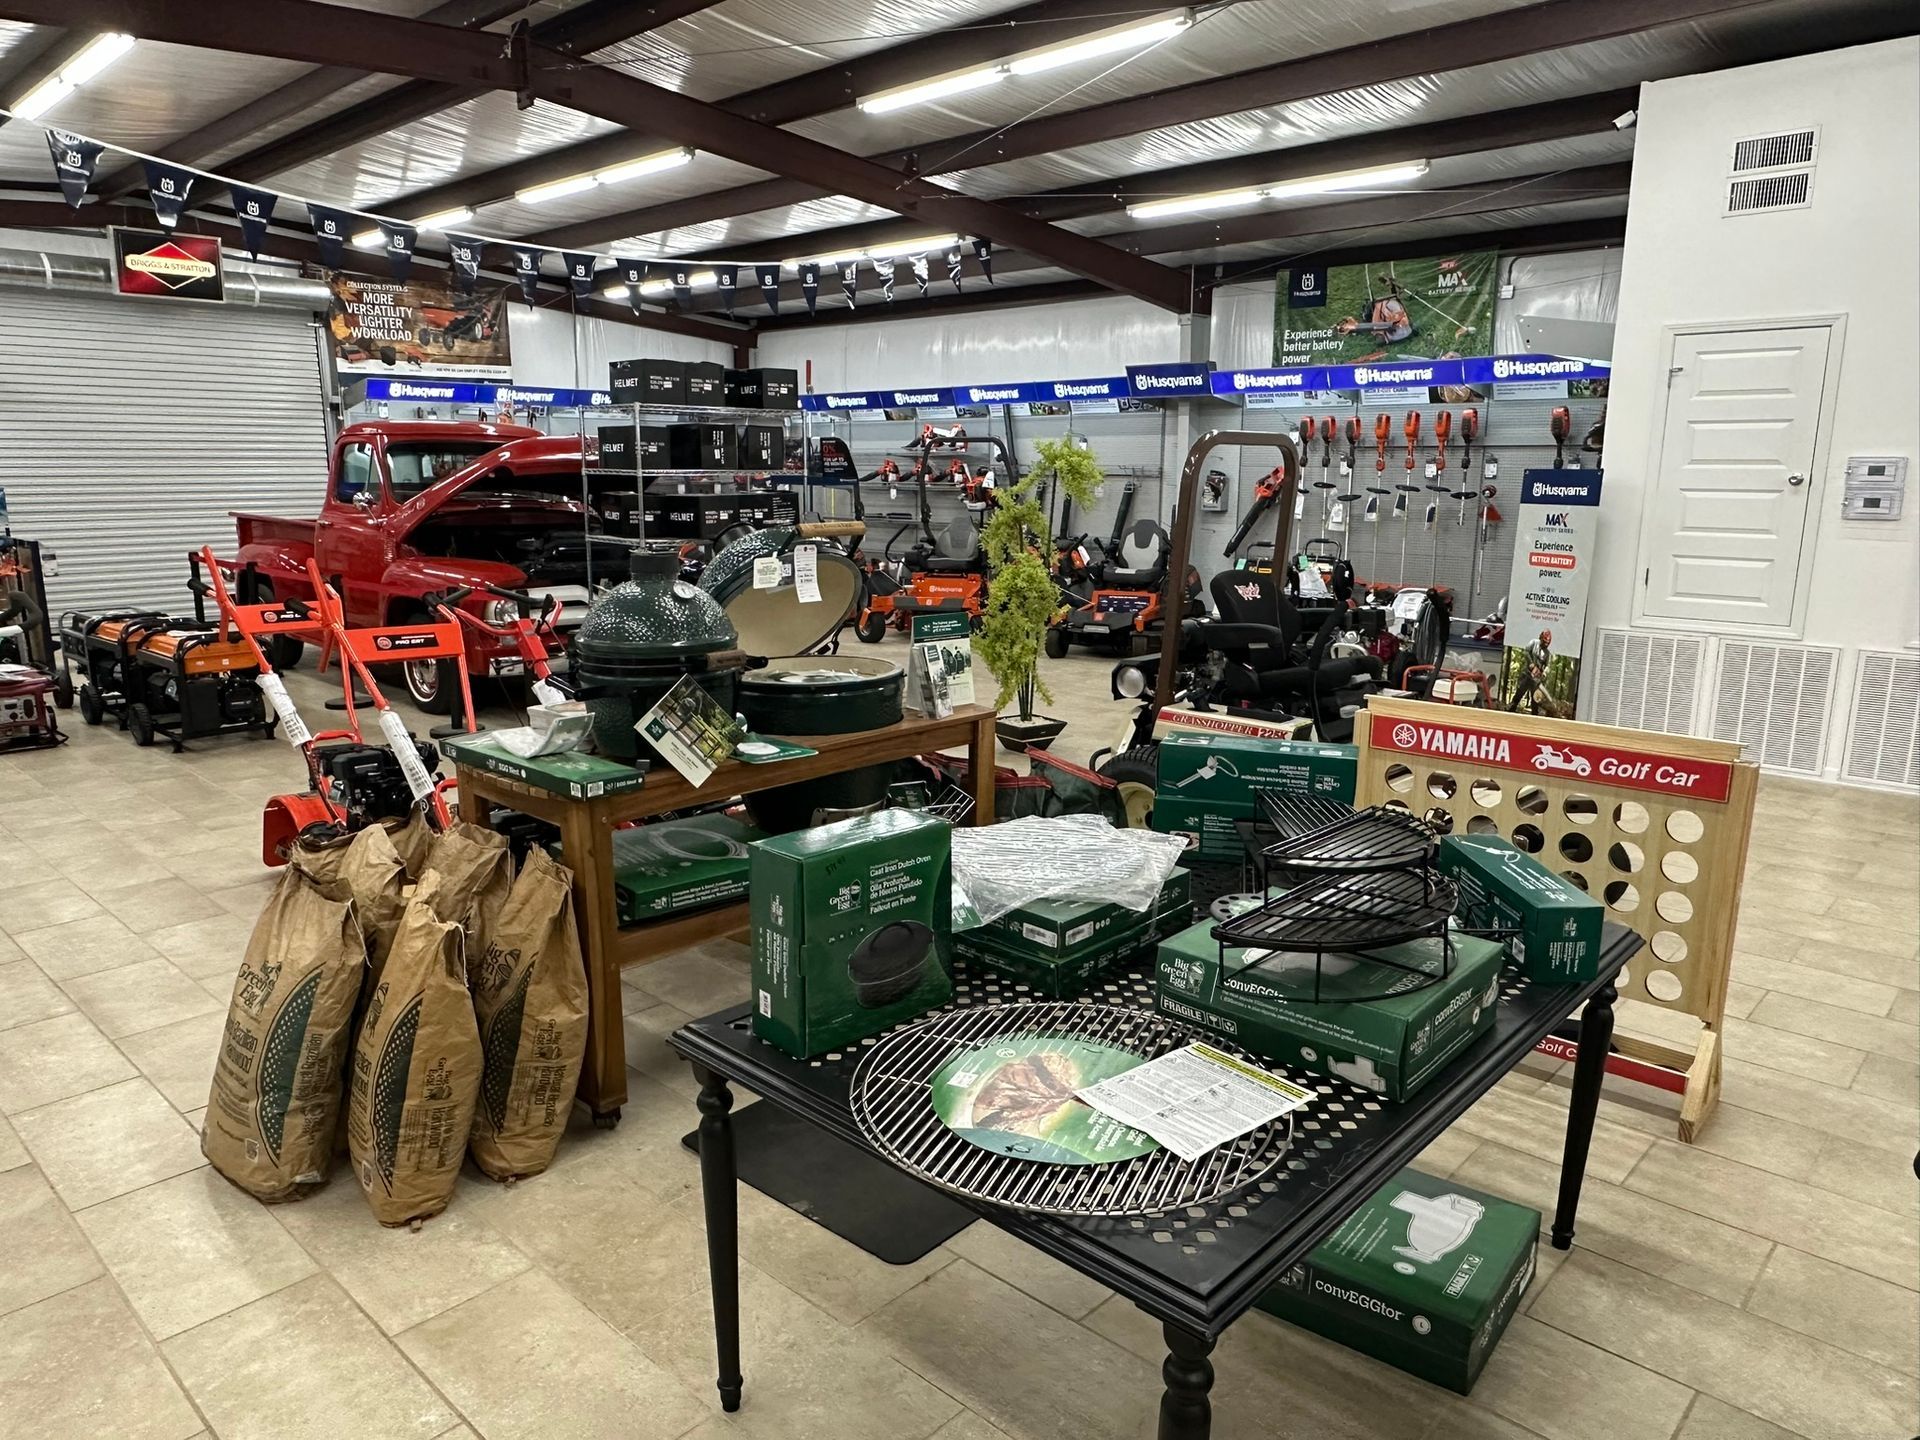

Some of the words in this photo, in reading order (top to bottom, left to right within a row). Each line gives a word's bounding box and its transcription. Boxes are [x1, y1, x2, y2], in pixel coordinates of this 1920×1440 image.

[171, 263, 211, 273] STRATTON
[346, 281, 381, 290] COLLECTION
[1437, 271, 1467, 288] MAX
[363, 292, 394, 305] MORE
[345, 302, 413, 318] VERSATILITY
[359, 315, 403, 329] LIGHTER
[351, 327, 412, 341] WORKLOAD
[1284, 328, 1333, 342] Experience
[1283, 341, 1310, 351] better
[1312, 340, 1344, 352] battery
[1282, 355, 1311, 366] power
[1510, 359, 1584, 376] Husqvarna
[1147, 375, 1203, 388] Husqvarna
[1246, 373, 1303, 387] Husqvarna
[1369, 367, 1433, 383] Husqvarna
[614, 377, 638, 388] HELMET
[741, 385, 757, 394] LMET
[401, 384, 455, 399] Husqvarna
[508, 388, 555, 402] Husqvarna
[978, 388, 1019, 400] Husqvarna
[1063, 383, 1109, 397] Husqvarna
[837, 396, 867, 407] Husqvarna
[903, 392, 939, 404] Husqvarna
[603, 443, 624, 452] HELMET
[1542, 484, 1588, 497] Husqvarna
[604, 511, 620, 520] HELMET
[670, 513, 694, 522] HELMET
[1545, 512, 1569, 527] MAX
[1534, 540, 1573, 552] Experience
[1531, 555, 1550, 564] BETTER
[1551, 556, 1573, 566] BATTERY
[1525, 593, 1546, 603] ACTIVE
[1546, 594, 1570, 605] COOLING
[1173, 714, 1254, 734] GRASSHOPPER
[1418, 727, 1511, 762] YAMAHA
[1598, 757, 1650, 782] Golf
[1654, 766, 1700, 788] Car
[870, 868, 884, 877] Cast
[884, 865, 897, 874] Iron
[898, 860, 915, 869] Dutch
[915, 855, 931, 864] Oven
[870, 884, 882, 892] Olla
[883, 875, 910, 888] Profunda
[878, 887, 898, 897] Hierro
[898, 878, 923, 892] Fundido
[839, 886, 850, 896] Big
[829, 893, 850, 905] Green
[837, 901, 850, 910] Egg
[1160, 962, 1188, 979] Green
[1174, 958, 1190, 970] Big
[238, 962, 268, 992] Green
[1169, 976, 1187, 989] Egg
[239, 982, 259, 1009] Egg
[1163, 999, 1202, 1021] FRAGILE
[1446, 1271, 1469, 1297] FRAGILE
[1315, 1280, 1401, 1320] convEGGtor
